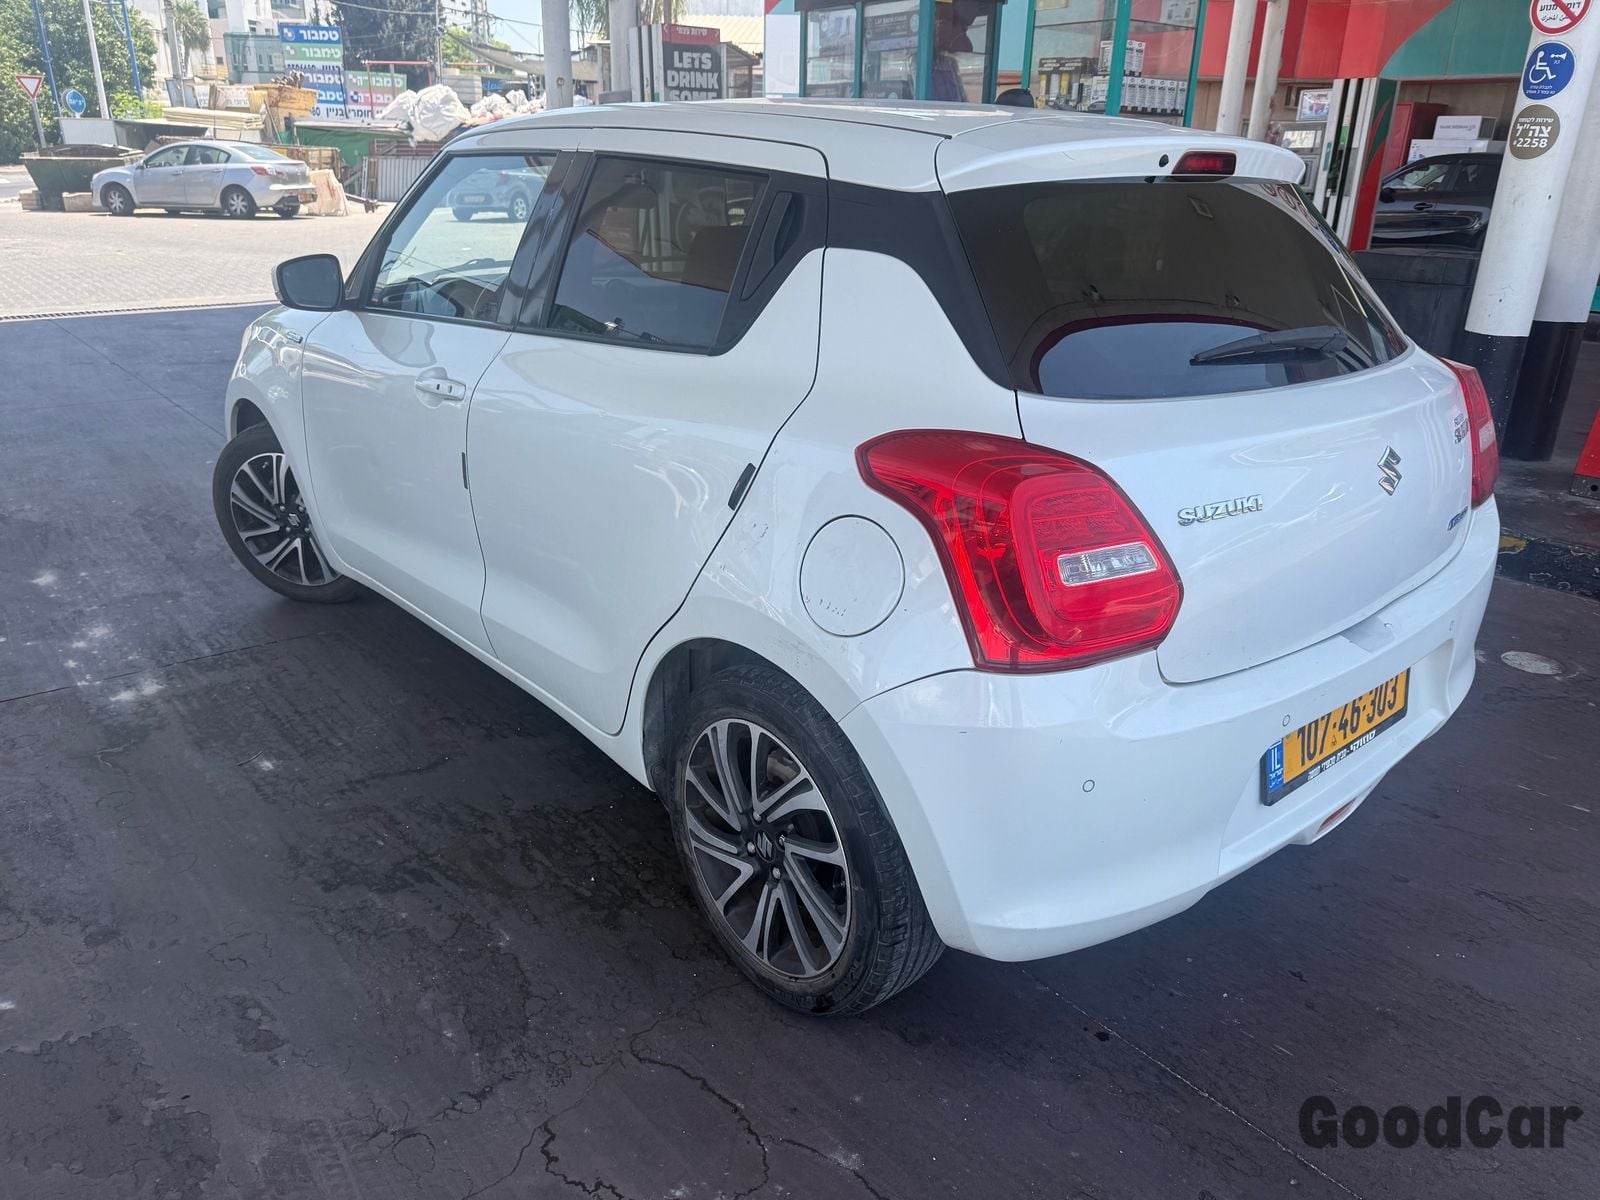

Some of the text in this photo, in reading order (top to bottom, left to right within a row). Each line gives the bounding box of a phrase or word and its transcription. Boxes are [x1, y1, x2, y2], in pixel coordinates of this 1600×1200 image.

[299, 30, 339, 41] טמבור
[302, 47, 341, 58] טמבור
[673, 50, 712, 70] LETS
[304, 73, 344, 84] טמבור
[667, 70, 719, 89] DRINK
[326, 107, 344, 118] בניין
[1178, 494, 1263, 526] SUZUKI
[1271, 747, 1281, 771] IL
